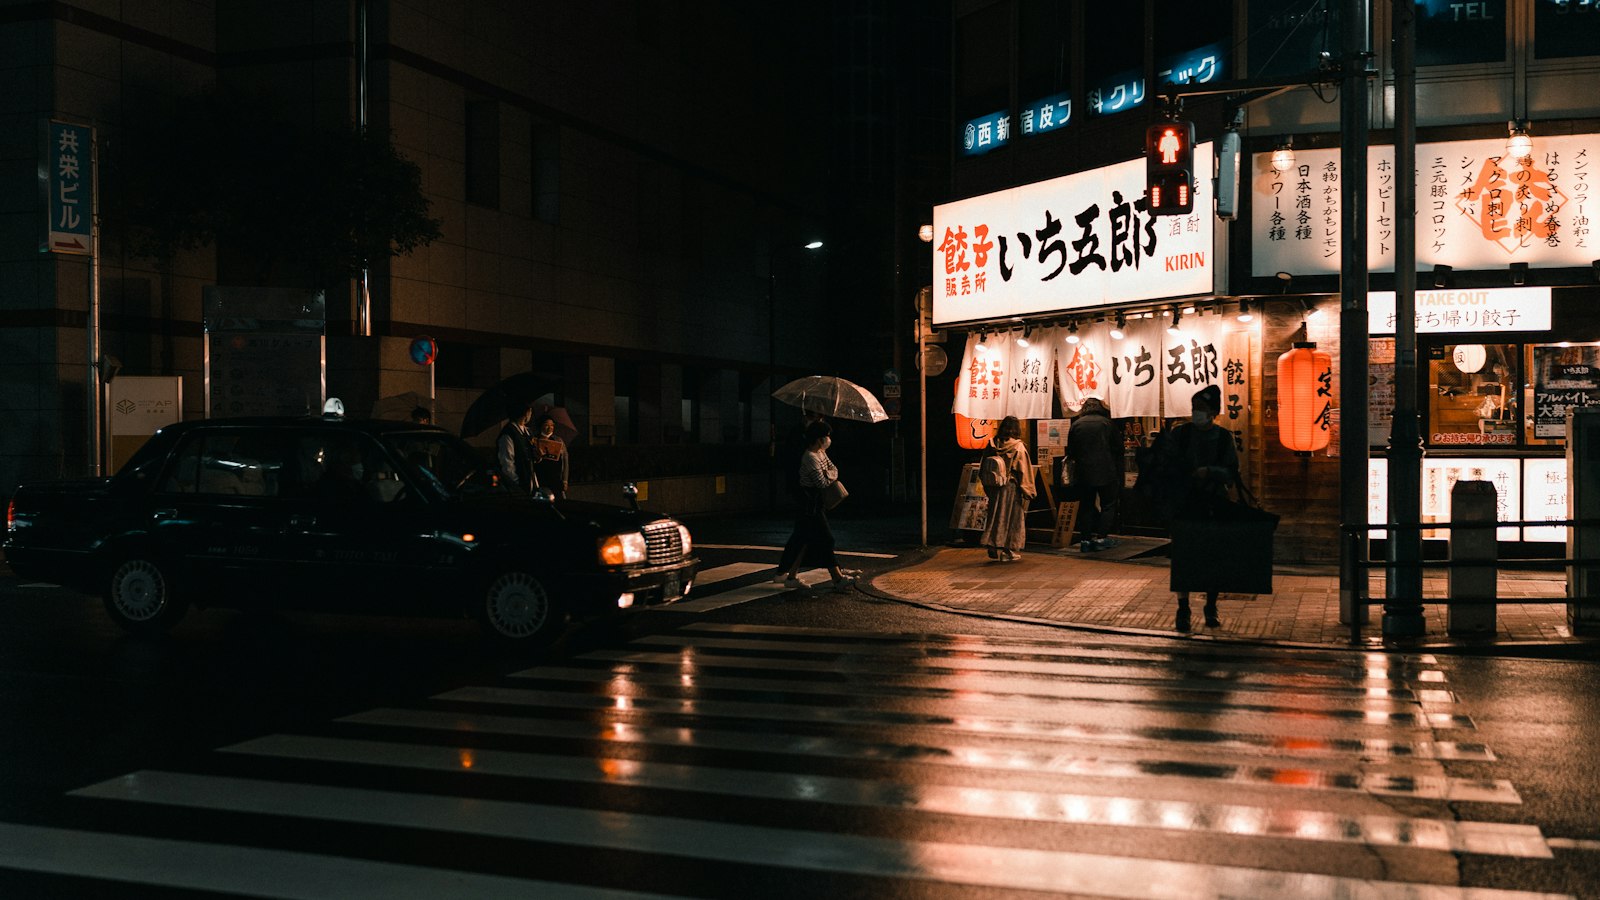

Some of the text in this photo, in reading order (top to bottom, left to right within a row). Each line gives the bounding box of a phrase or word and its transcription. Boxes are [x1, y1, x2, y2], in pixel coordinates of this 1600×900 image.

[1450, 1, 1494, 21] TEL
[58, 128, 81, 230] 共栄ビル
[1295, 164, 1312, 240] 日本酒各種
[1322, 161, 1338, 258] 名物かちかちレモン
[1376, 159, 1391, 255] ホッピーセット
[1430, 157, 1448, 253] 三元豚コロッケ
[1460, 156, 1475, 216] シメサバ
[1488, 156, 1504, 233] マグロ刺し
[1544, 151, 1561, 248] はるさめ春巻
[1573, 148, 1590, 249] メンマのラー油和え
[938, 224, 993, 274] 餃子
[997, 190, 1157, 282] いち五郎
[1165, 251, 1205, 272] KIRIN
[945, 272, 986, 298] 販売所
[1417, 291, 1489, 306] TAKE OUT
[967, 356, 1004, 386] 餃子
[1537, 392, 1589, 404] アルバイト
